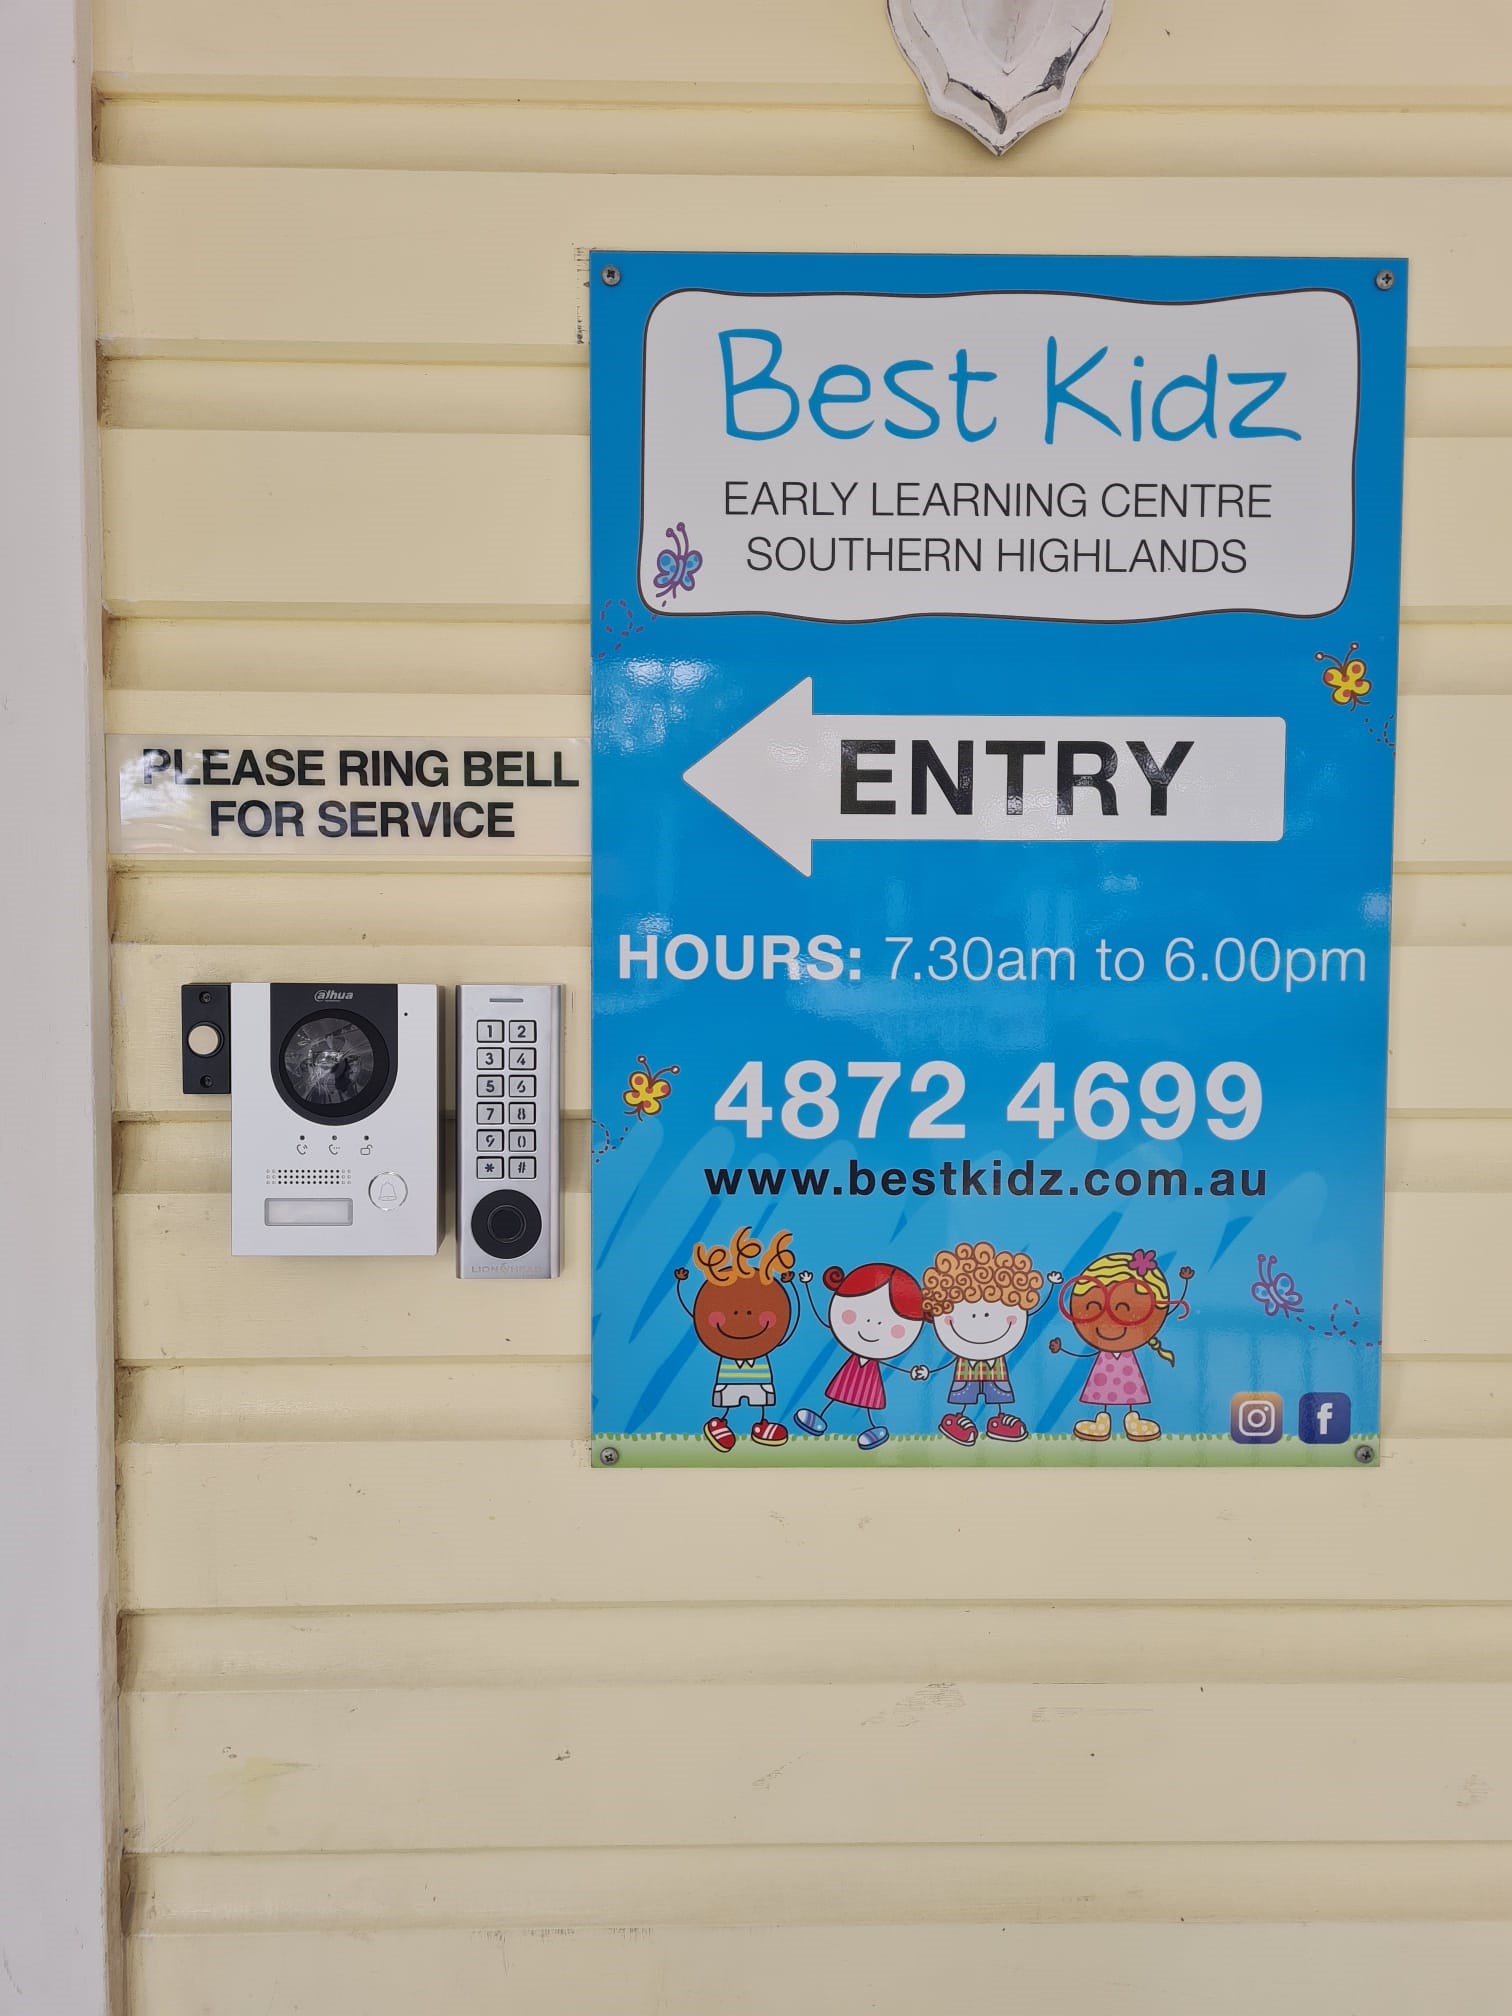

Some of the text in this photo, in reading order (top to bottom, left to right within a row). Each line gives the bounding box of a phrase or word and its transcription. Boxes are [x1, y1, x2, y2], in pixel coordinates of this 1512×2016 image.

[718, 328, 1303, 446] Best Kidz
[724, 481, 1273, 519] EARLY LEARNING CENTRE
[745, 537, 1248, 574] SOUTHERN HIGHLANDS
[143, 748, 580, 787] PLEASE RING BELL
[840, 739, 1195, 817] ENTRY
[211, 800, 515, 838] FOR SERVICE
[618, 934, 1367, 993] HOURS: 7.30am to 6.00pm
[487, 1024, 493, 1038] 1
[517, 1025, 526, 1038] 2
[485, 1052, 494, 1065] 3
[516, 1052, 526, 1065] 4
[485, 1080, 495, 1092] 5
[516, 1080, 526, 1093] 6
[713, 1060, 1263, 1141] 4872 4699
[486, 1108, 494, 1120] 7
[517, 1107, 526, 1120] 8
[485, 1135, 495, 1147] 9
[517, 1135, 526, 1148] 0
[704, 1160, 1267, 1197] www.bestkidz.com.au
